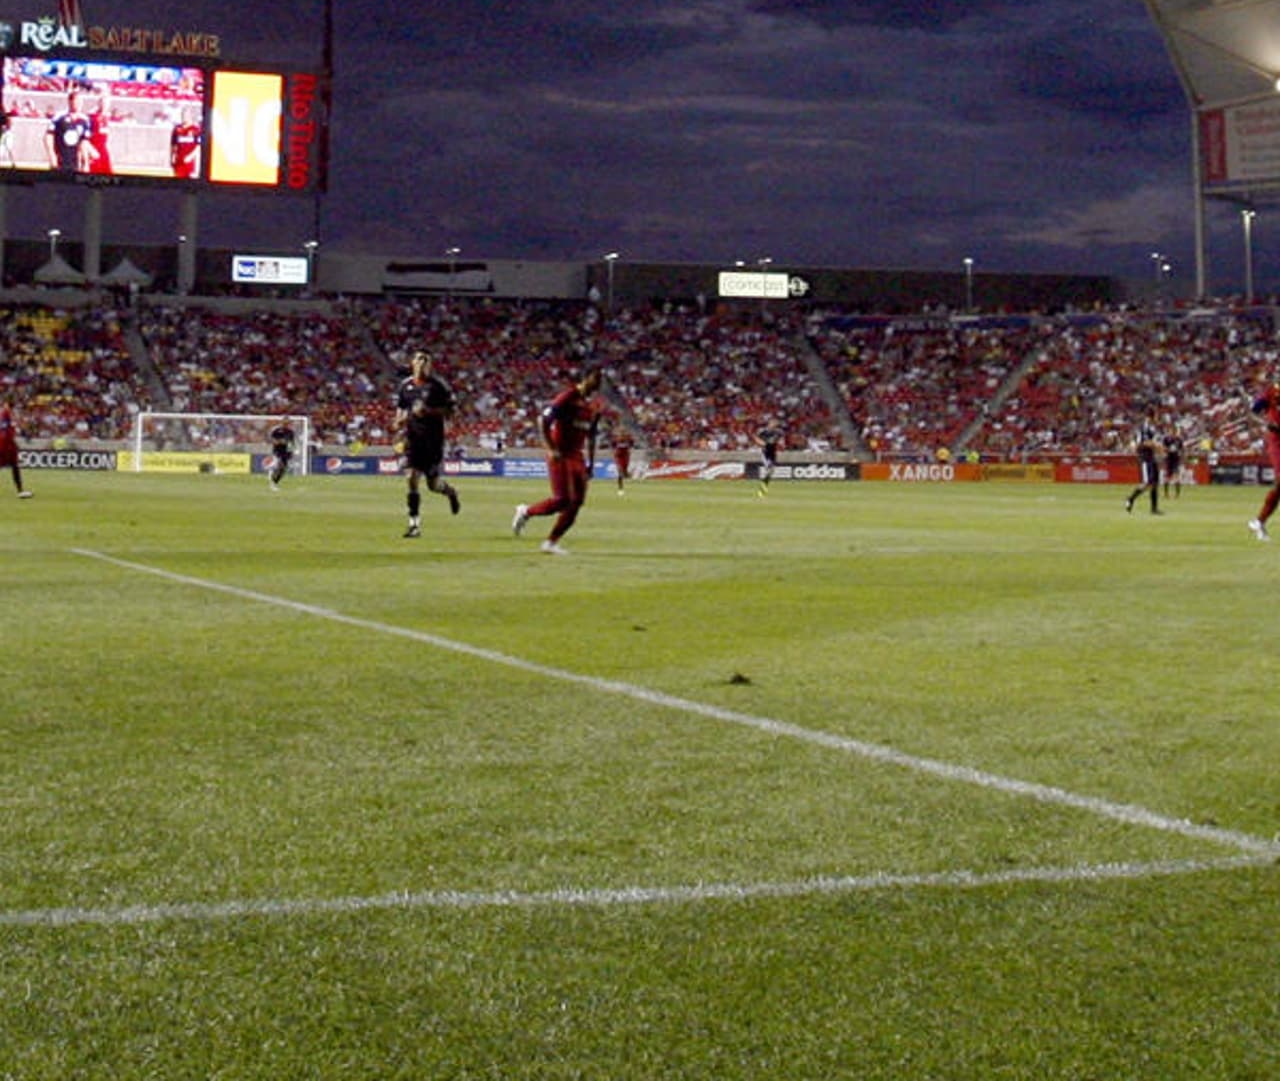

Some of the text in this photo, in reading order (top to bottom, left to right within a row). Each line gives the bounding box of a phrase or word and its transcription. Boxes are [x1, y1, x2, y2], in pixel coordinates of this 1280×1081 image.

[152, 29, 220, 58] LAKE
[795, 464, 846, 479] adidas
[890, 465, 955, 481] XANGO
